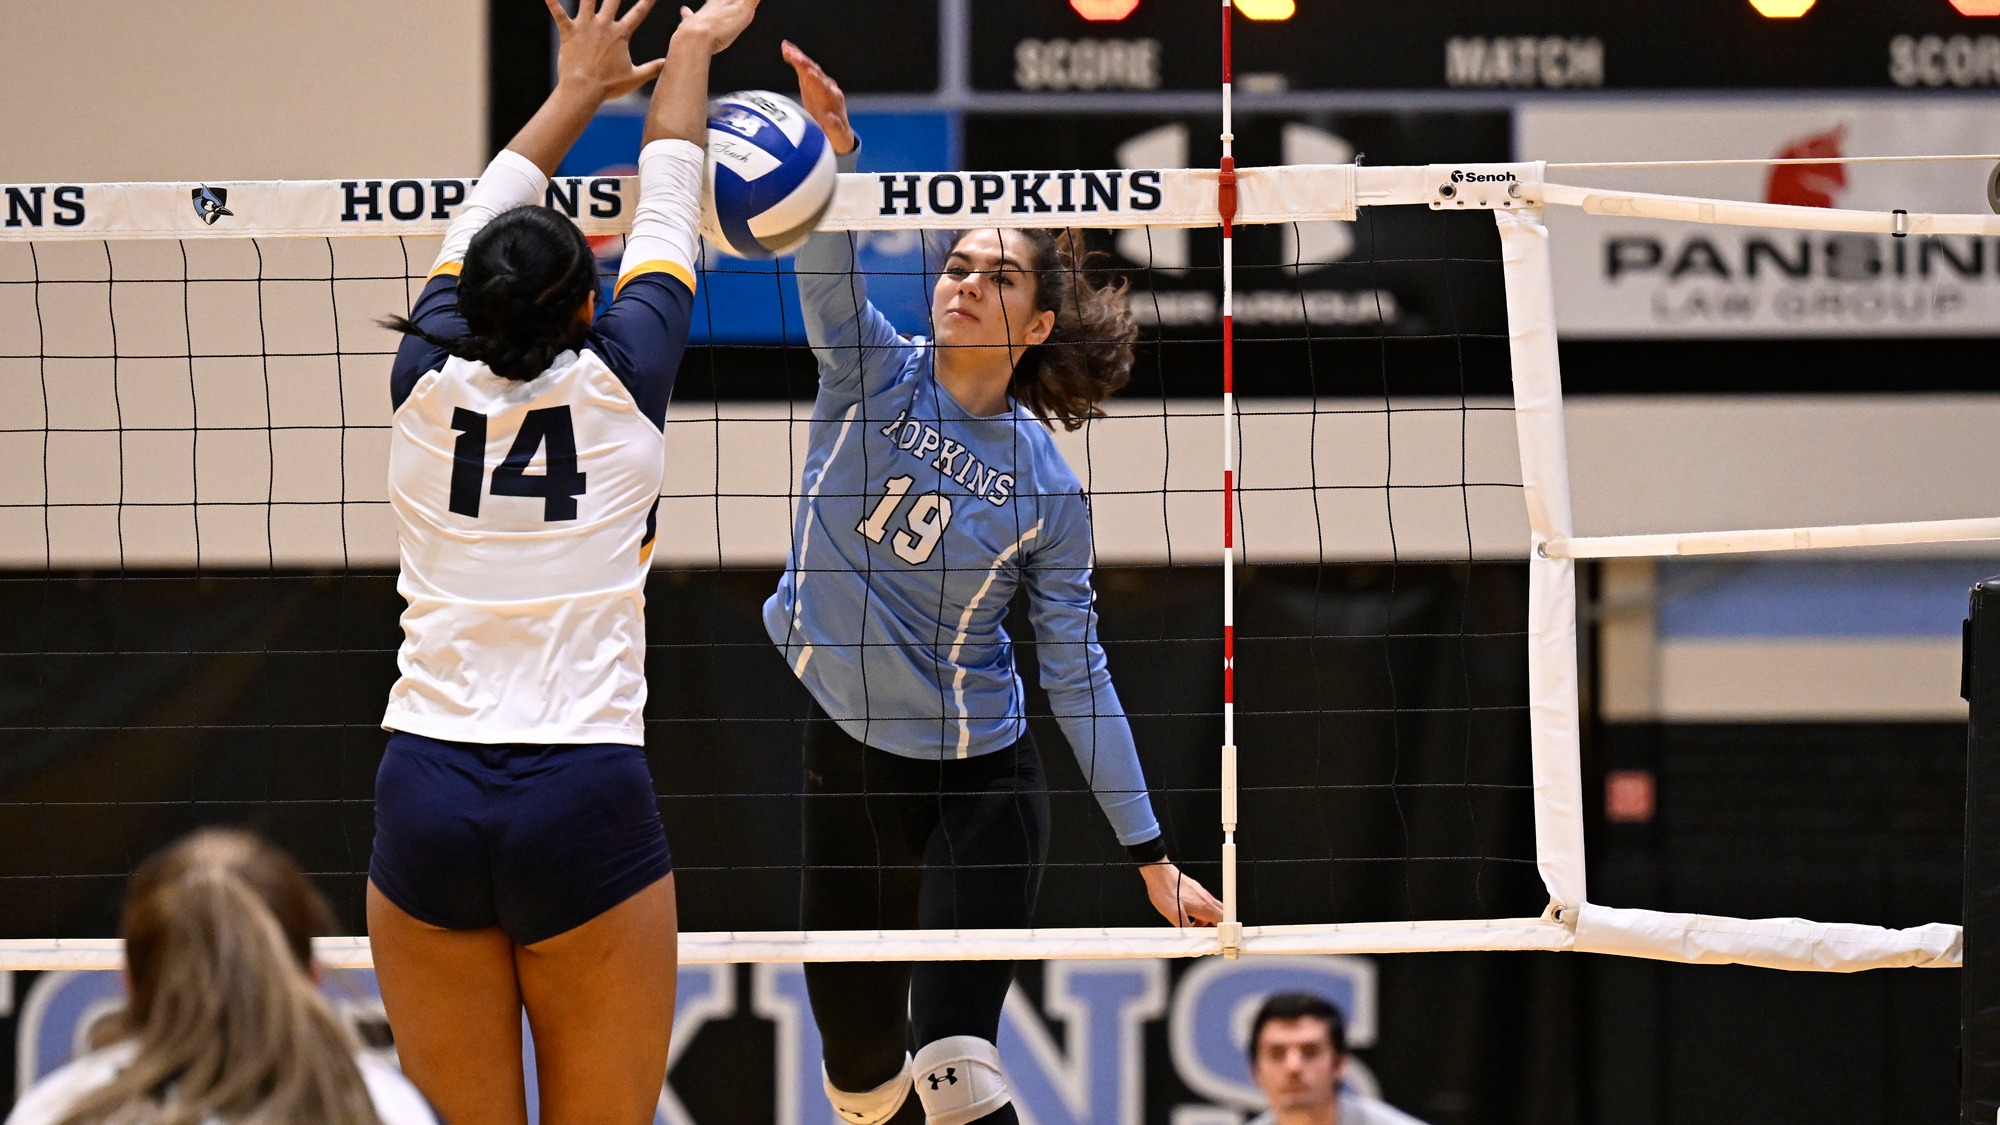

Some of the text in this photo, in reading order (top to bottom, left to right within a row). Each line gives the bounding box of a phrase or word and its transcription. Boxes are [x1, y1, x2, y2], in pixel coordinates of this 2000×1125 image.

[1013, 38, 1161, 90] SCORE
[1444, 36, 1605, 87] MATCH
[340, 178, 622, 222] HOPNS
[879, 170, 1162, 215] HOPKINS
[1465, 171, 1516, 183] Senoh
[1605, 235, 2000, 281] PANSIN
[448, 404, 587, 522] 14
[855, 473, 952, 565] 19
